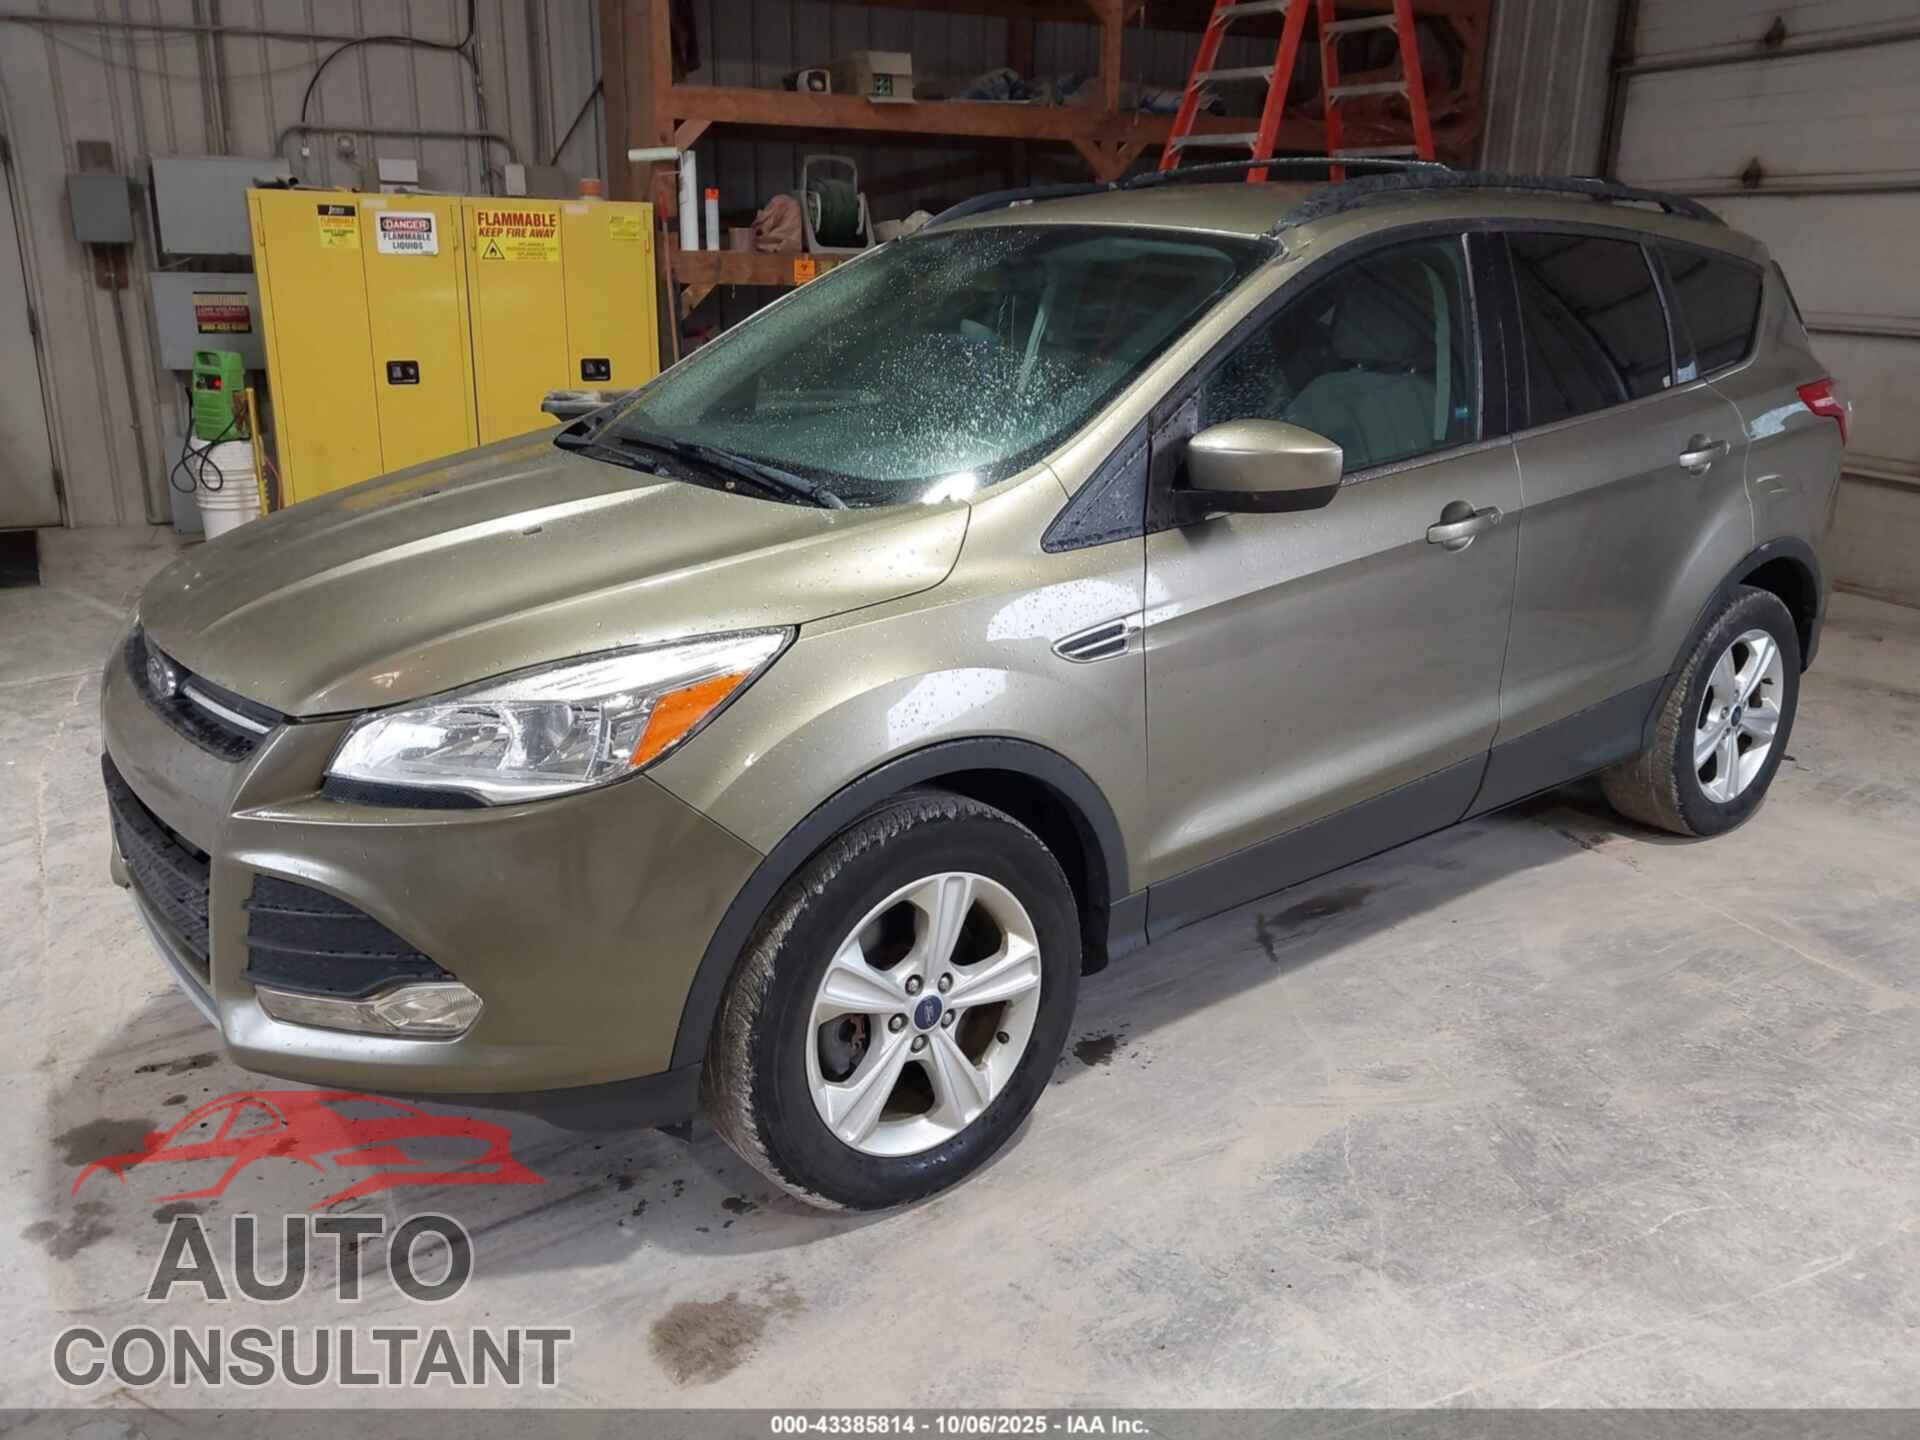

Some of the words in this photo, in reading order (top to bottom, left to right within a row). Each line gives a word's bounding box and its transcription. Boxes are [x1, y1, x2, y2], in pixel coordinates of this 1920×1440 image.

[384, 219, 427, 229] DANGER
[477, 212, 556, 227] FLAMMABLE
[383, 232, 431, 241] FLAMMABLE
[478, 227, 503, 238] KEEP
[506, 228, 527, 238] FIRE
[529, 229, 556, 239] AWAY
[392, 242, 423, 250] LIQUIDS
